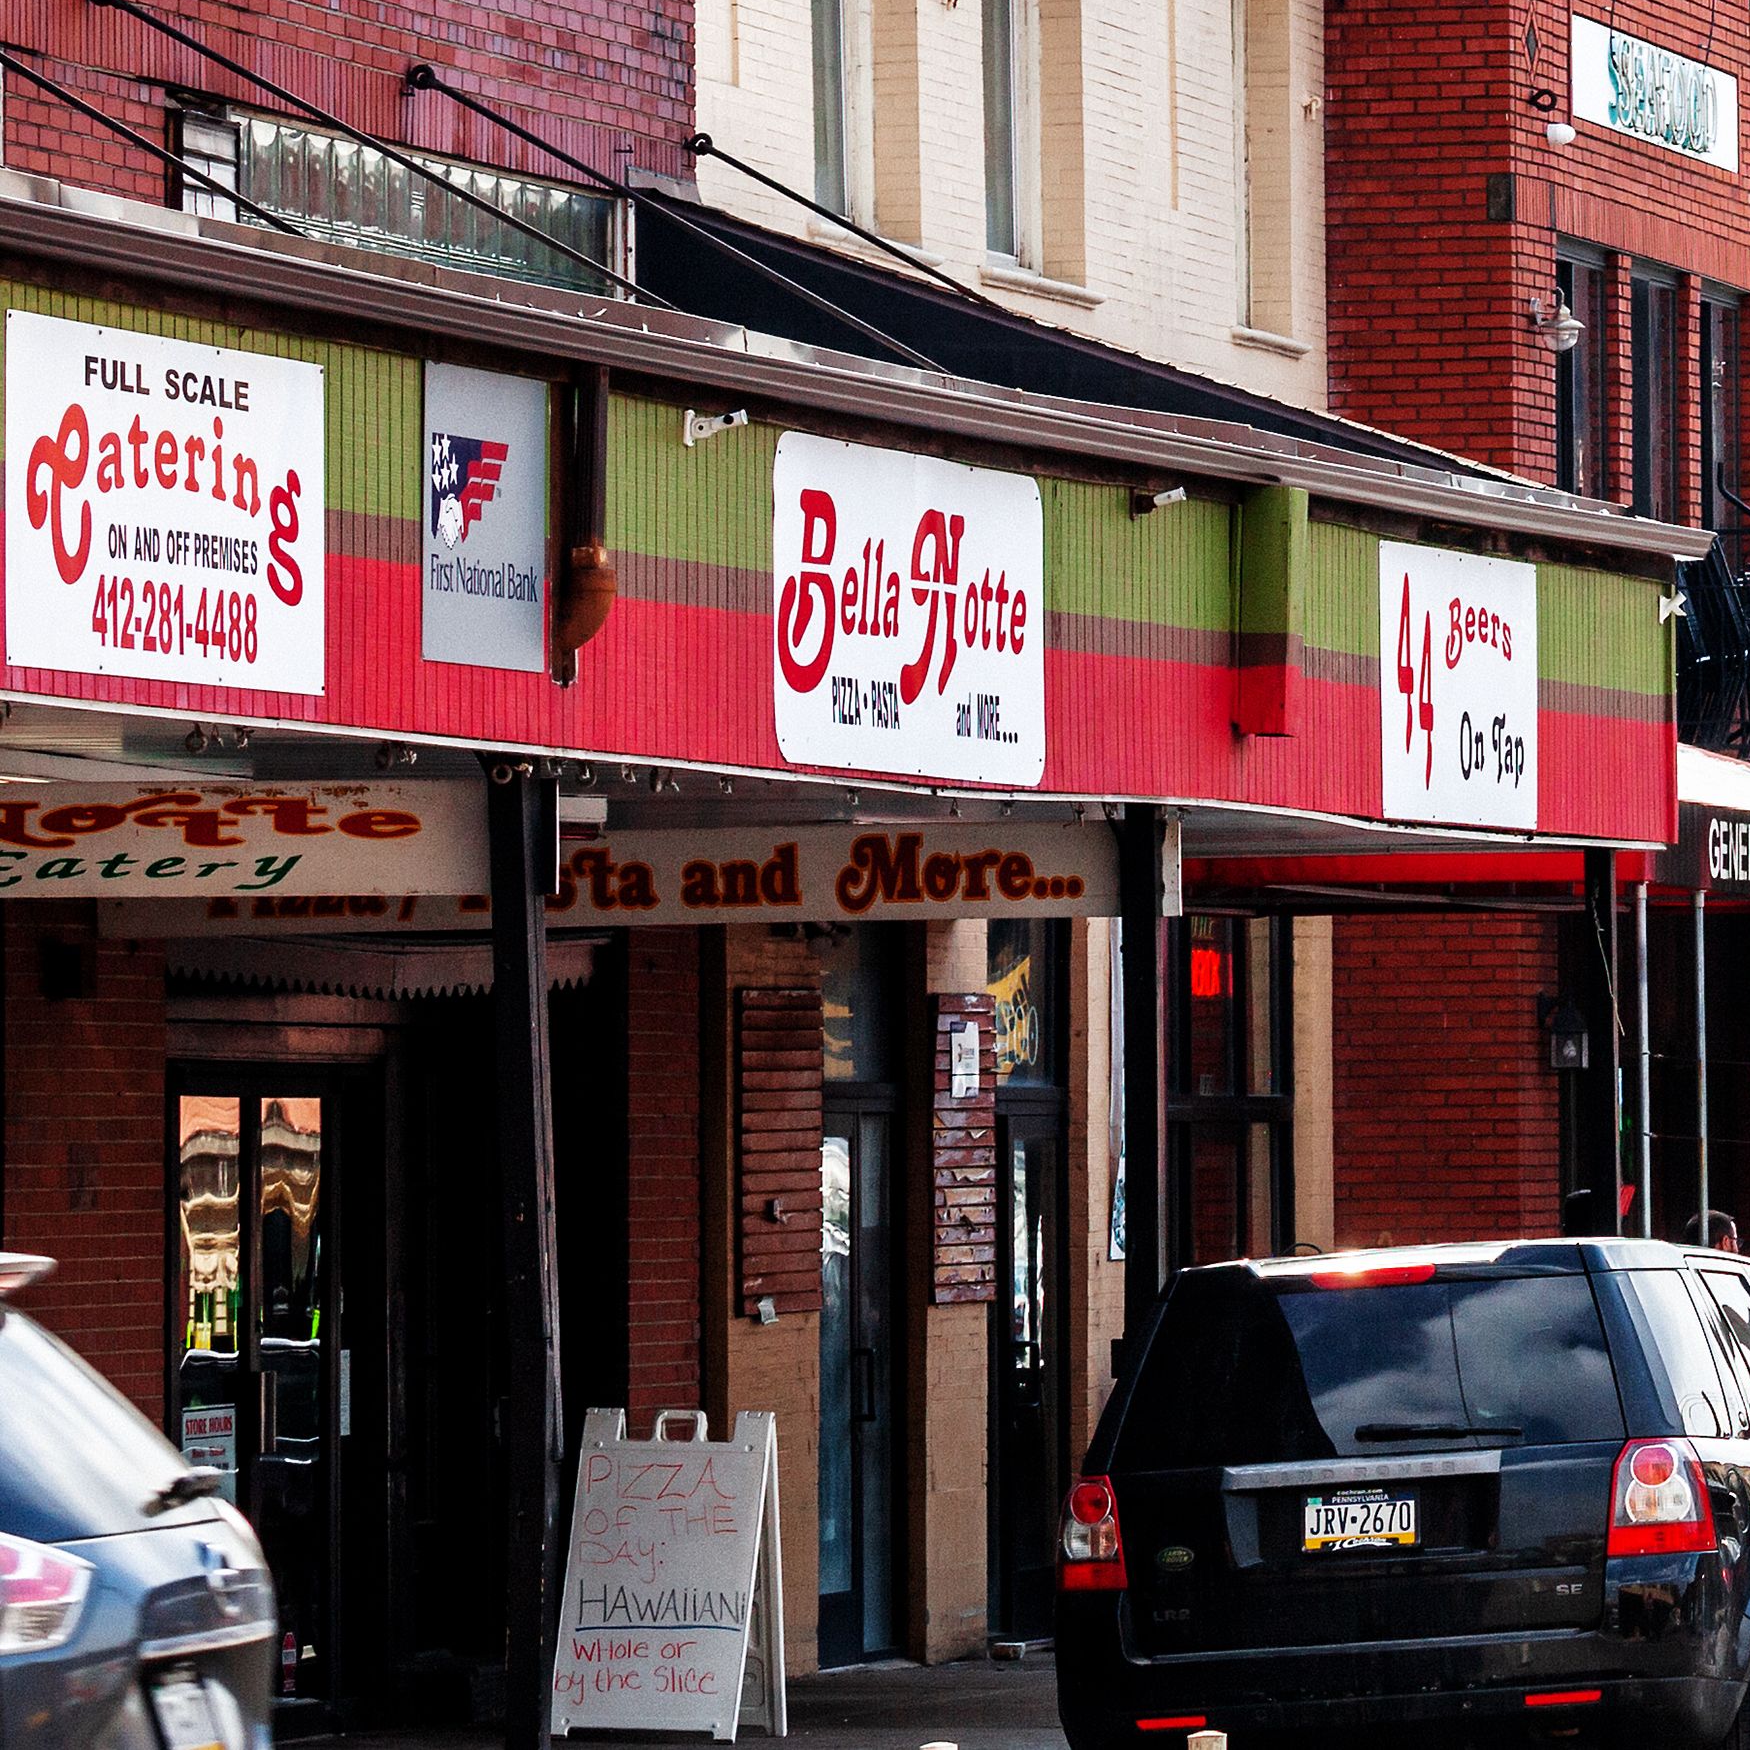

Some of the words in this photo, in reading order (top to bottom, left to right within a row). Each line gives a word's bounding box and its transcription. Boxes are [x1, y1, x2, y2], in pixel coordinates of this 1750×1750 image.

[84, 354, 150, 396] FULL
[164, 368, 250, 412] SCALE
[26, 403, 303, 607] Catering
[107, 523, 128, 560] ON
[133, 526, 161, 565] AND
[166, 529, 190, 569] OFF
[194, 533, 258, 576] PREMISES
[431, 553, 455, 593] First
[456, 556, 505, 600] National
[508, 562, 538, 603] Bank
[778, 488, 900, 694] Bella
[899, 508, 1027, 706] Notte
[92, 573, 258, 665] 412-281-4488
[1445, 597, 1512, 670] Beers
[832, 676, 861, 726] PIZZA
[872, 680, 900, 730] PASTA
[956, 692, 972, 738] and
[1460, 711, 1485, 781] On
[1492, 713, 1525, 789] Tap
[682, 842, 802, 909] and
[835, 832, 1085, 914] More...
[185, 1417, 207, 1436] STORE
[586, 1455, 737, 1500] PIZZA
[1331, 1493, 1390, 1504] PENNSYLVANIA
[584, 1505, 638, 1536] OF
[658, 1505, 739, 1536] THE
[1556, 1584, 1583, 1596] SE
[660, 1640, 698, 1661] or
[554, 1669, 585, 1706] by
[595, 1668, 642, 1693] the
